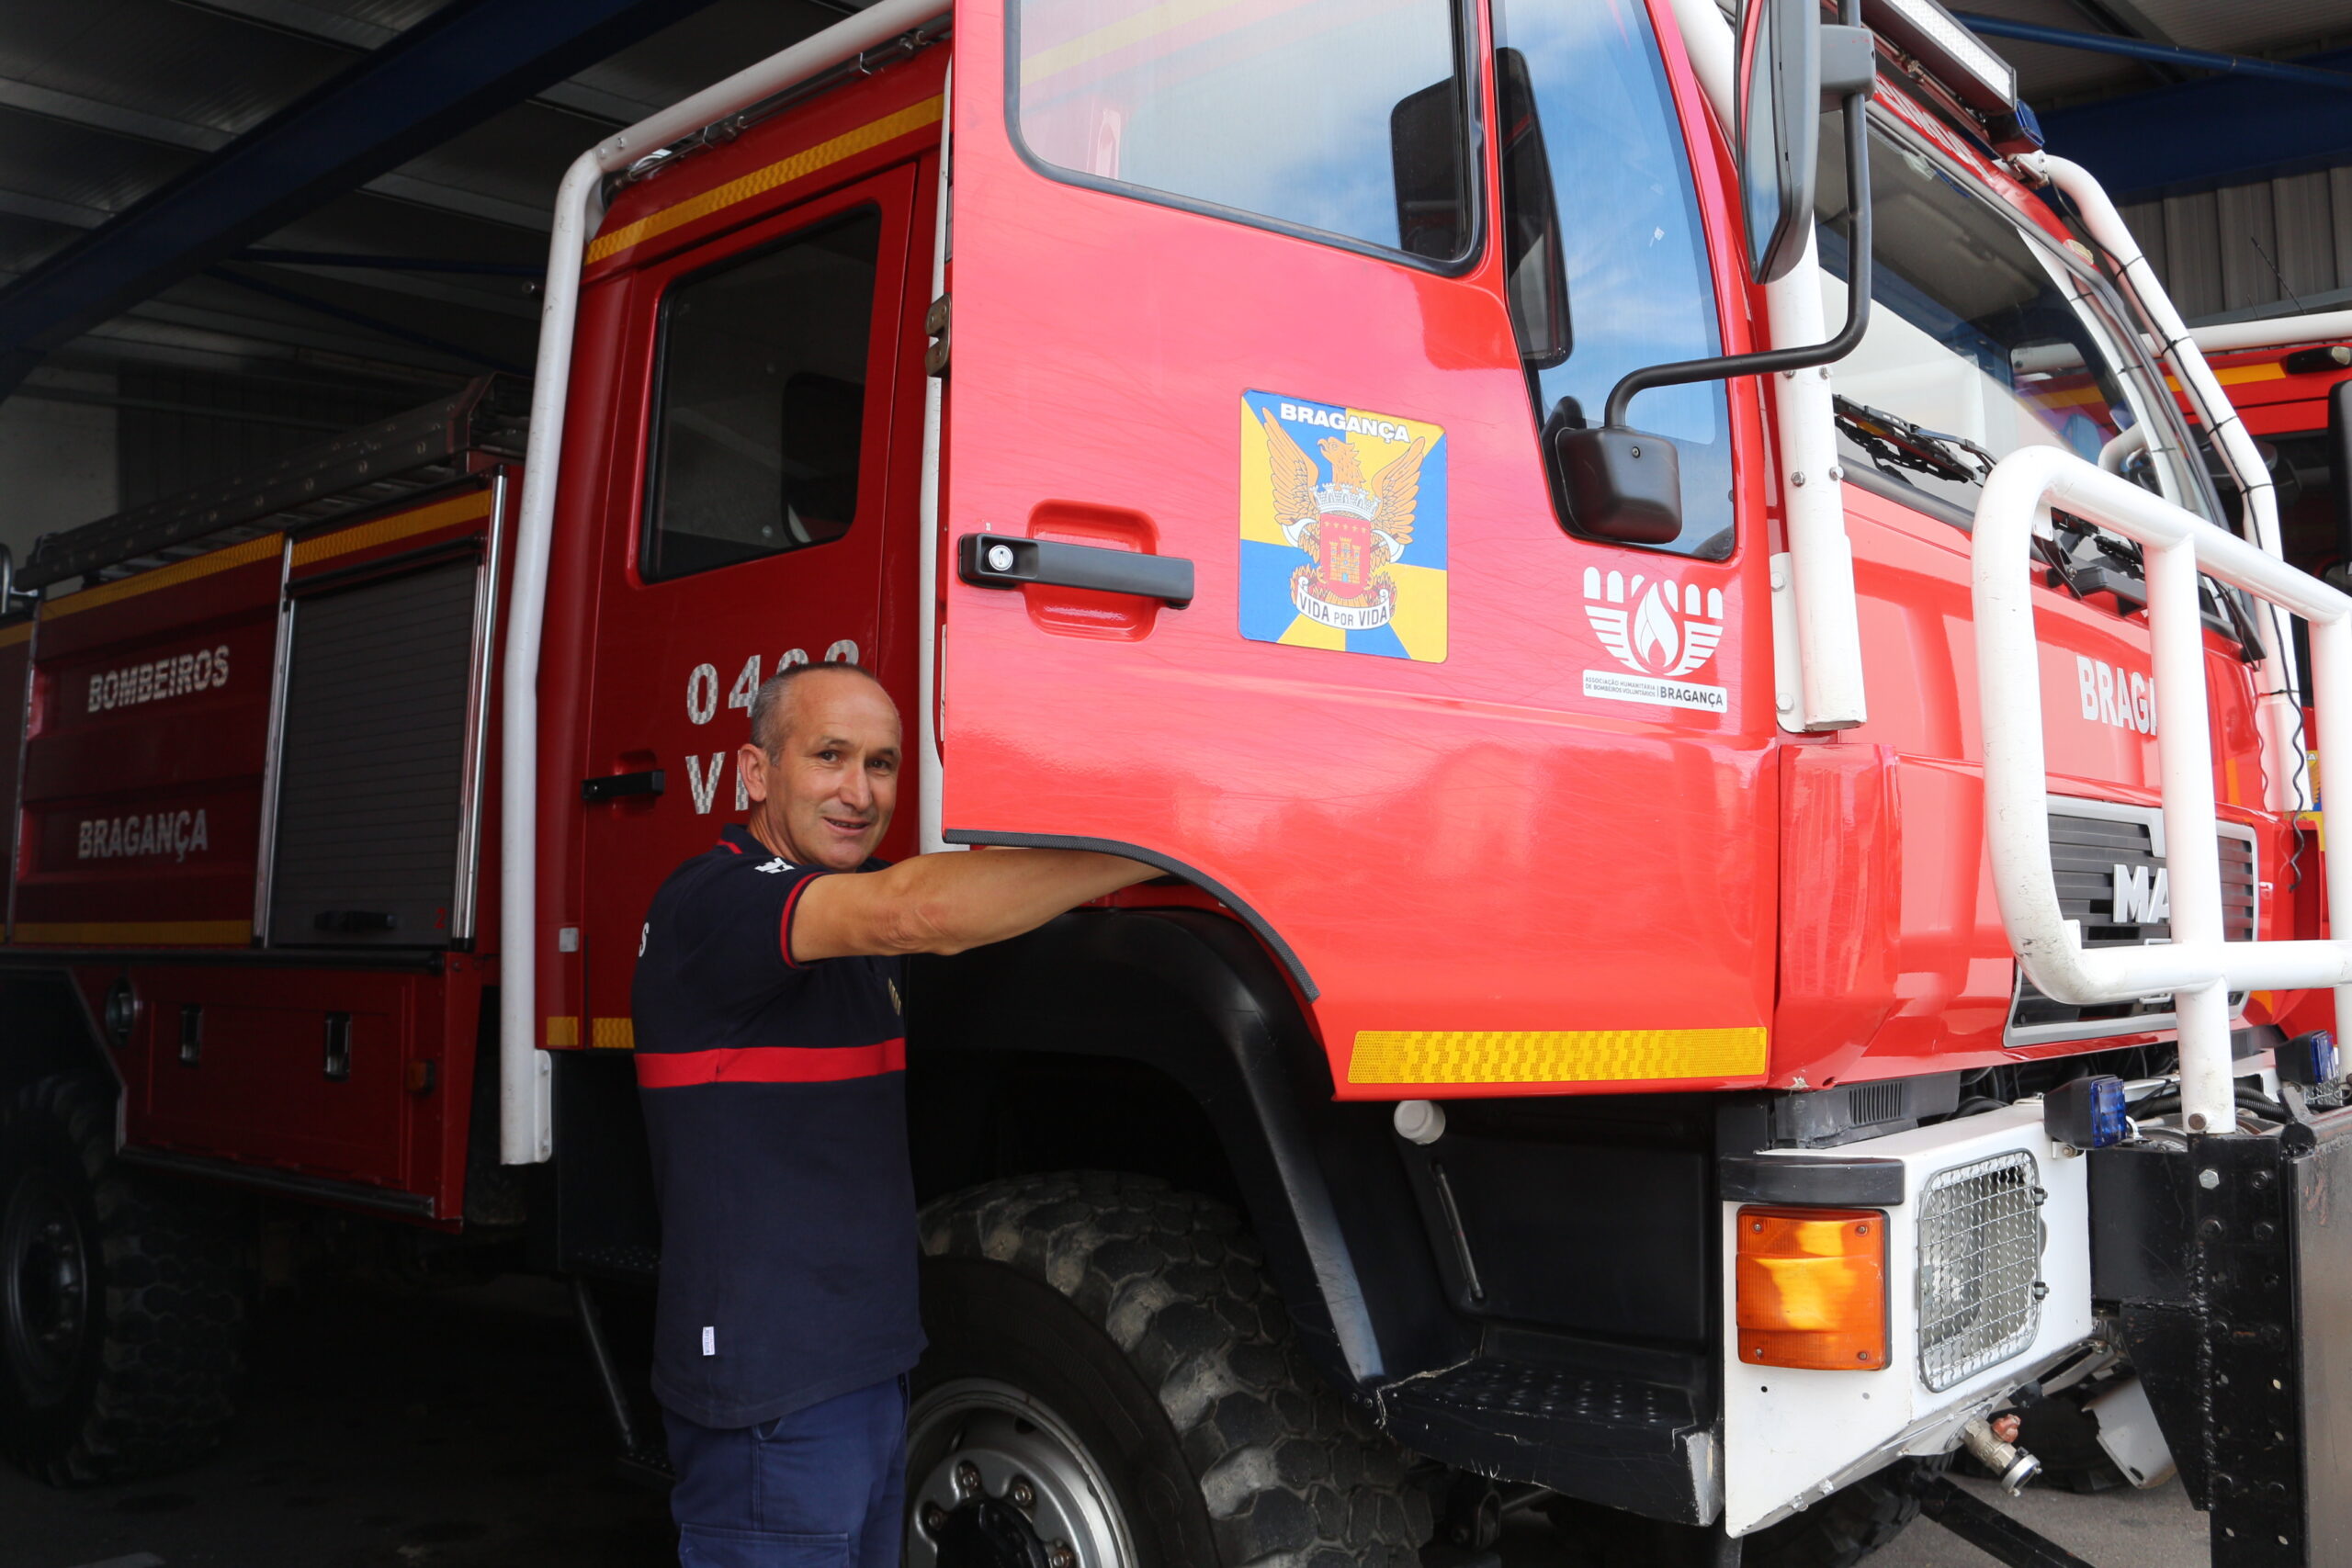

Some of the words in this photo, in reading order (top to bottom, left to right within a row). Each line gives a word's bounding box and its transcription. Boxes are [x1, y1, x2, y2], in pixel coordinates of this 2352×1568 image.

[1281, 403, 1410, 443] BRAGANÇA
[1299, 592, 1329, 622] VIDA
[1334, 611, 1353, 626] POR
[1359, 606, 1388, 626] VIDA
[88, 645, 230, 713] BOMBEIROS
[686, 639, 860, 725] 04
[1593, 684, 1622, 694] BOMBEIROS
[1660, 686, 1724, 706] BRAGANÇA
[78, 809, 208, 862] BRAGANÇA
[434, 907, 447, 930] 2
[639, 921, 650, 957] S
